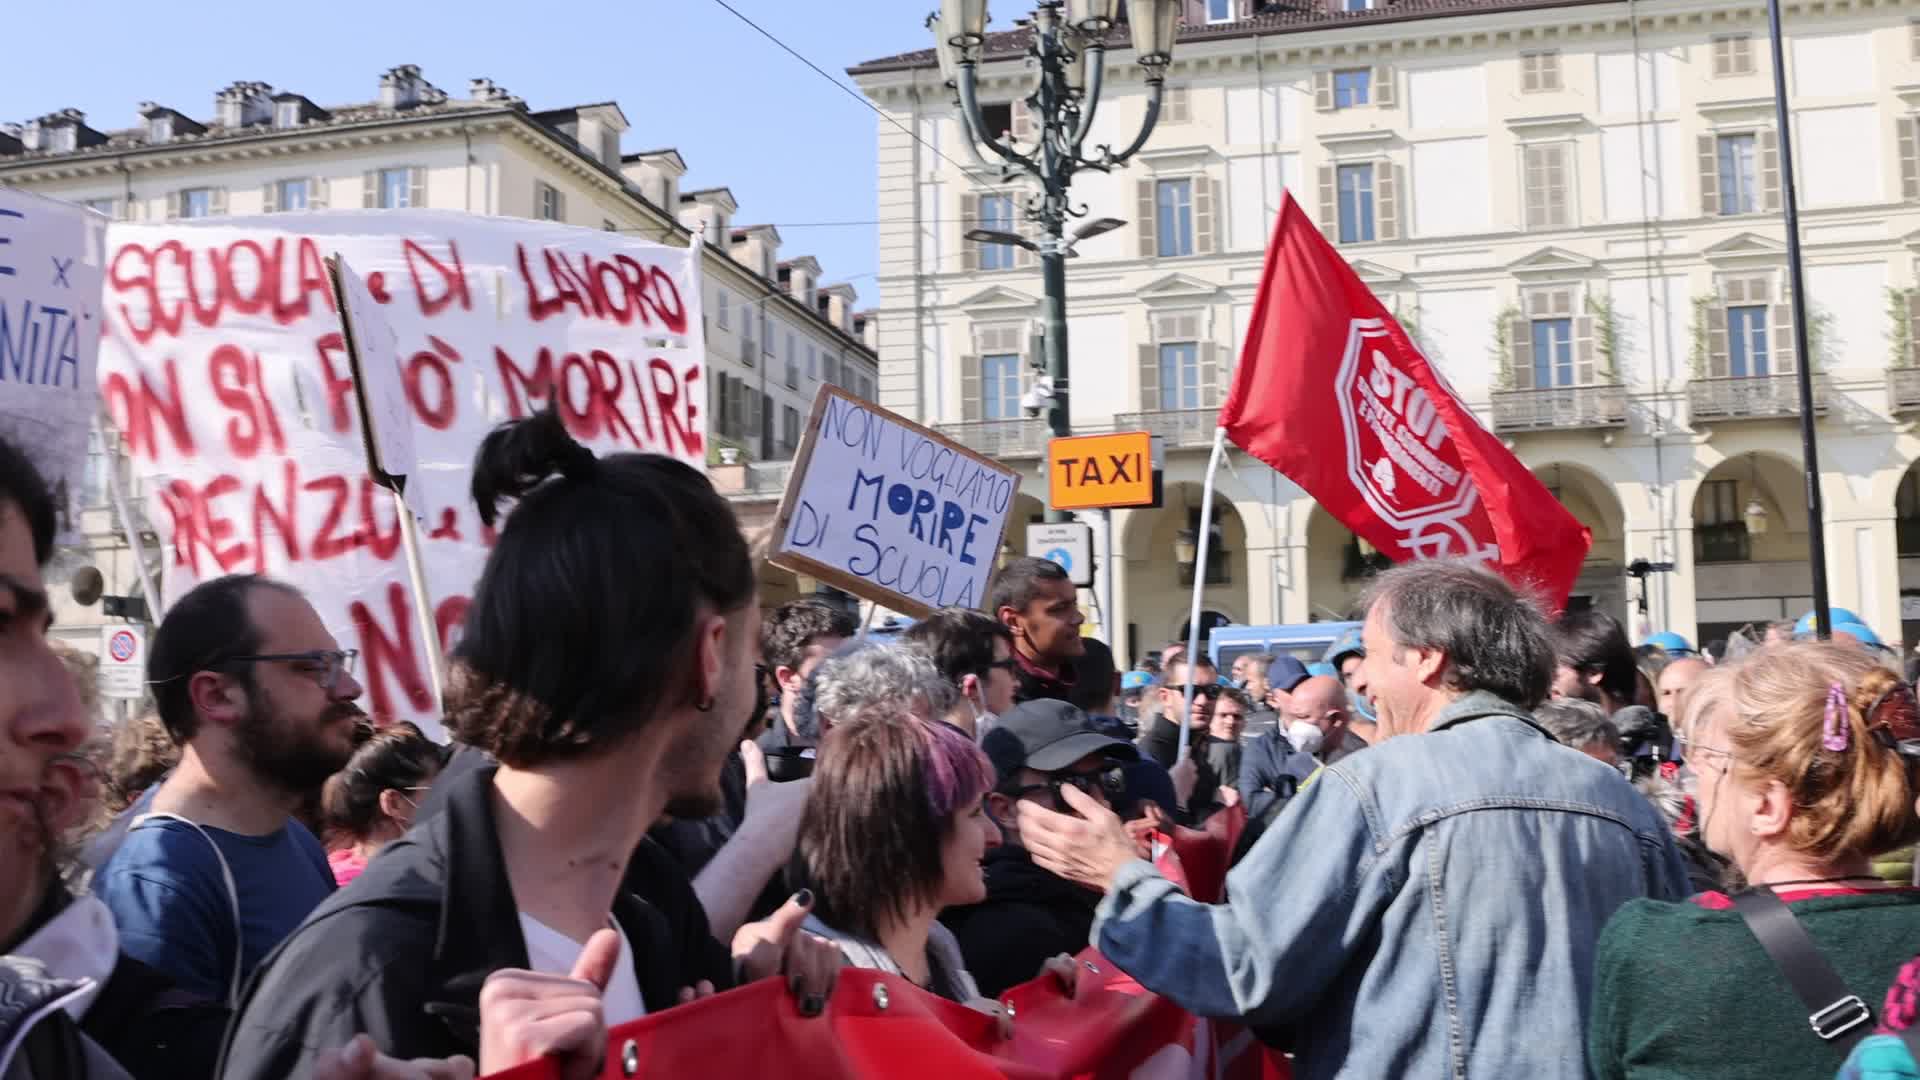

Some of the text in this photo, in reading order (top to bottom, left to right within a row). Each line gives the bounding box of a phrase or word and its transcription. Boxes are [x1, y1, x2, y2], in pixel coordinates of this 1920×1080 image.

[109, 237, 337, 344] SCUOLA
[402, 239, 472, 317] DI
[516, 242, 687, 336] LAVORO
[208, 344, 287, 458] SI
[315, 332, 461, 434] PÒ
[494, 346, 704, 457] MORIRE
[823, 395, 1011, 515] NON VOGLIAMO
[1057, 453, 1142, 487] TAXI
[791, 500, 976, 609] DI SCUOLA
[847, 468, 988, 565] MORIRE
